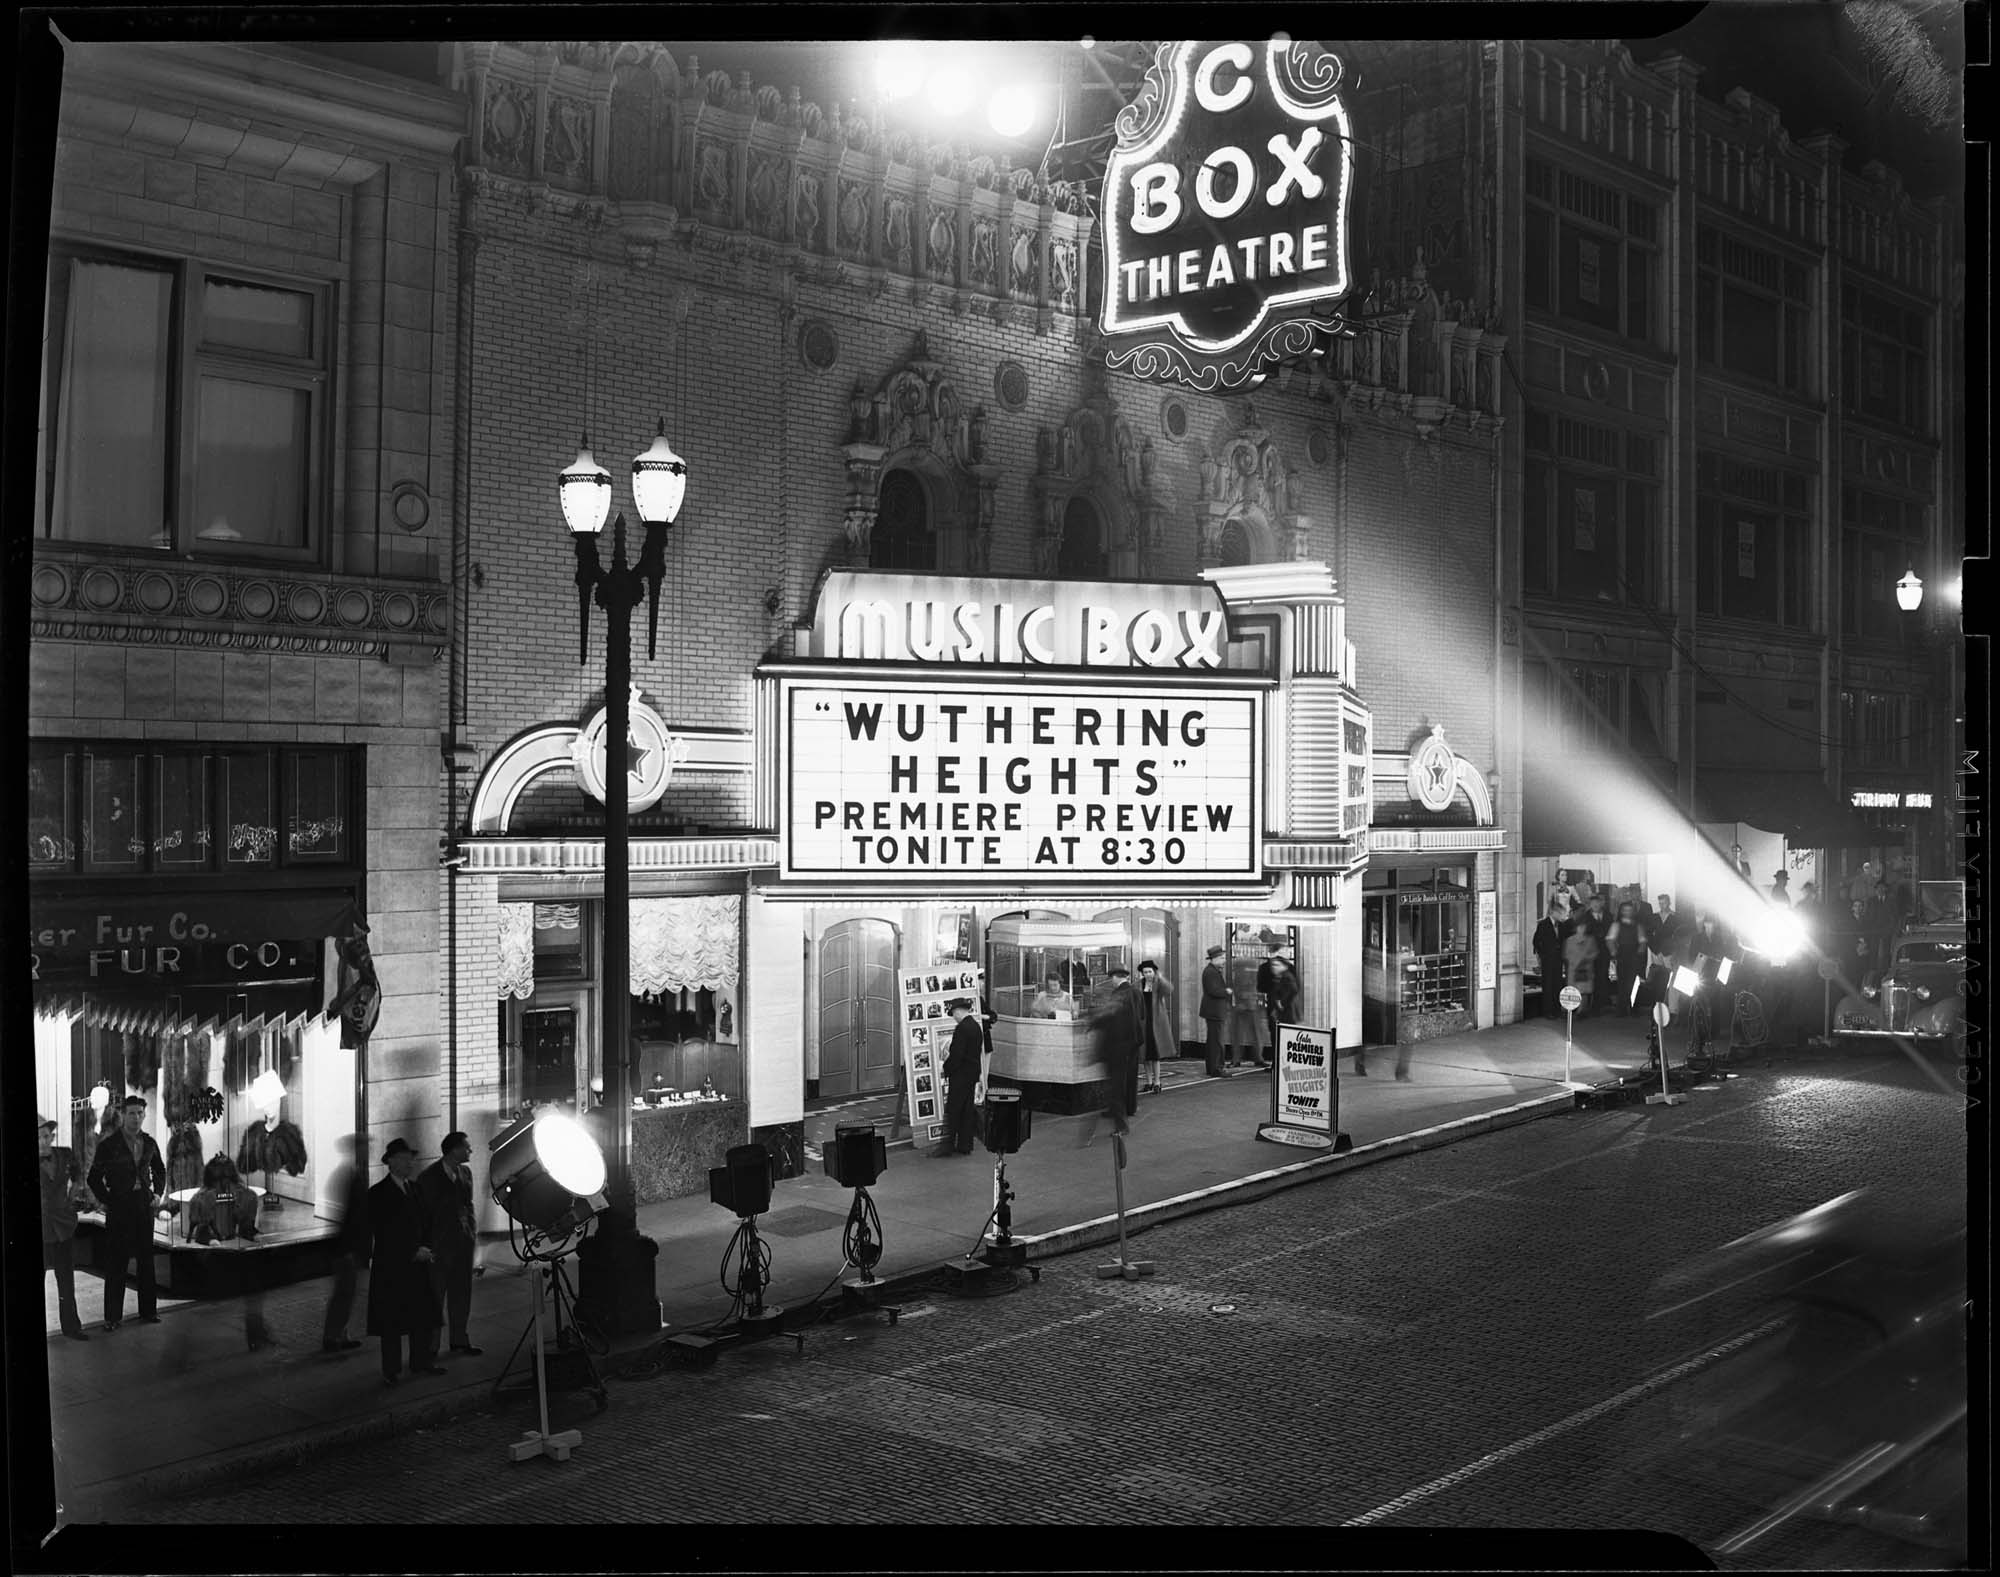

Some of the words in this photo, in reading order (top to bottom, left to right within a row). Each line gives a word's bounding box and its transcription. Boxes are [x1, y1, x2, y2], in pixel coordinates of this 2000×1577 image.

[1130, 126, 1323, 234] BOX
[1120, 224, 1328, 303] THEATRE
[839, 601, 1055, 664] MUSIC
[1081, 606, 1223, 669] BOX
[815, 701, 1206, 748] “WUTHERING
[891, 755, 1187, 796] HEIGHTS”
[815, 801, 1021, 831] PREMIERE
[1057, 804, 1233, 832] PREVIEW
[853, 835, 1000, 864] TONITE
[1035, 837, 1080, 864] AT
[1100, 837, 1185, 865] 8:30
[1439, 891, 1456, 901] Coffee
[97, 914, 153, 945] Fur
[169, 911, 217, 941] Co.
[90, 946, 181, 977] FUR
[227, 941, 296, 970] CO.
[1286, 1041, 1324, 1056] PREMIERE
[1286, 1052, 1324, 1067] PREVIEW
[1282, 1065, 1327, 1082] WUTHERING
[1287, 1094, 1320, 1108] TONITE
